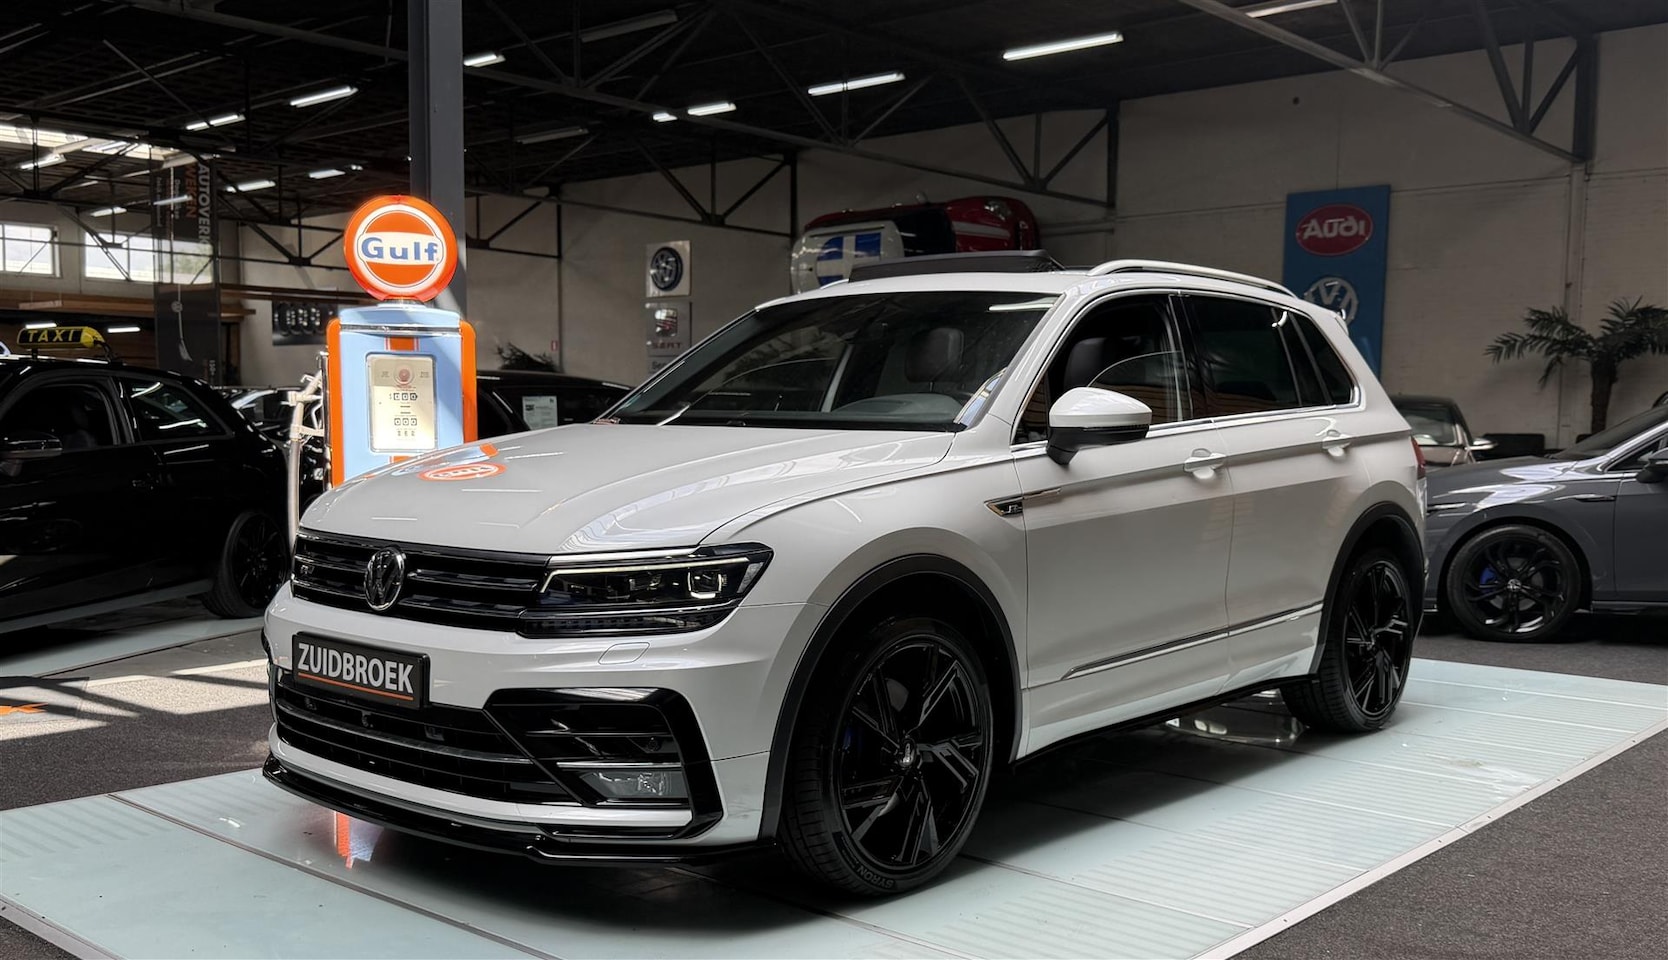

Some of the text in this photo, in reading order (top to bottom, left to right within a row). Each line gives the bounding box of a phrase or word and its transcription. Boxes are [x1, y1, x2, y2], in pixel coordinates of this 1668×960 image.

[361, 236, 438, 261] Gulf
[27, 329, 75, 342] TAXI
[297, 643, 413, 694] ZUIDBROEK
[856, 865, 894, 888] SYRON
